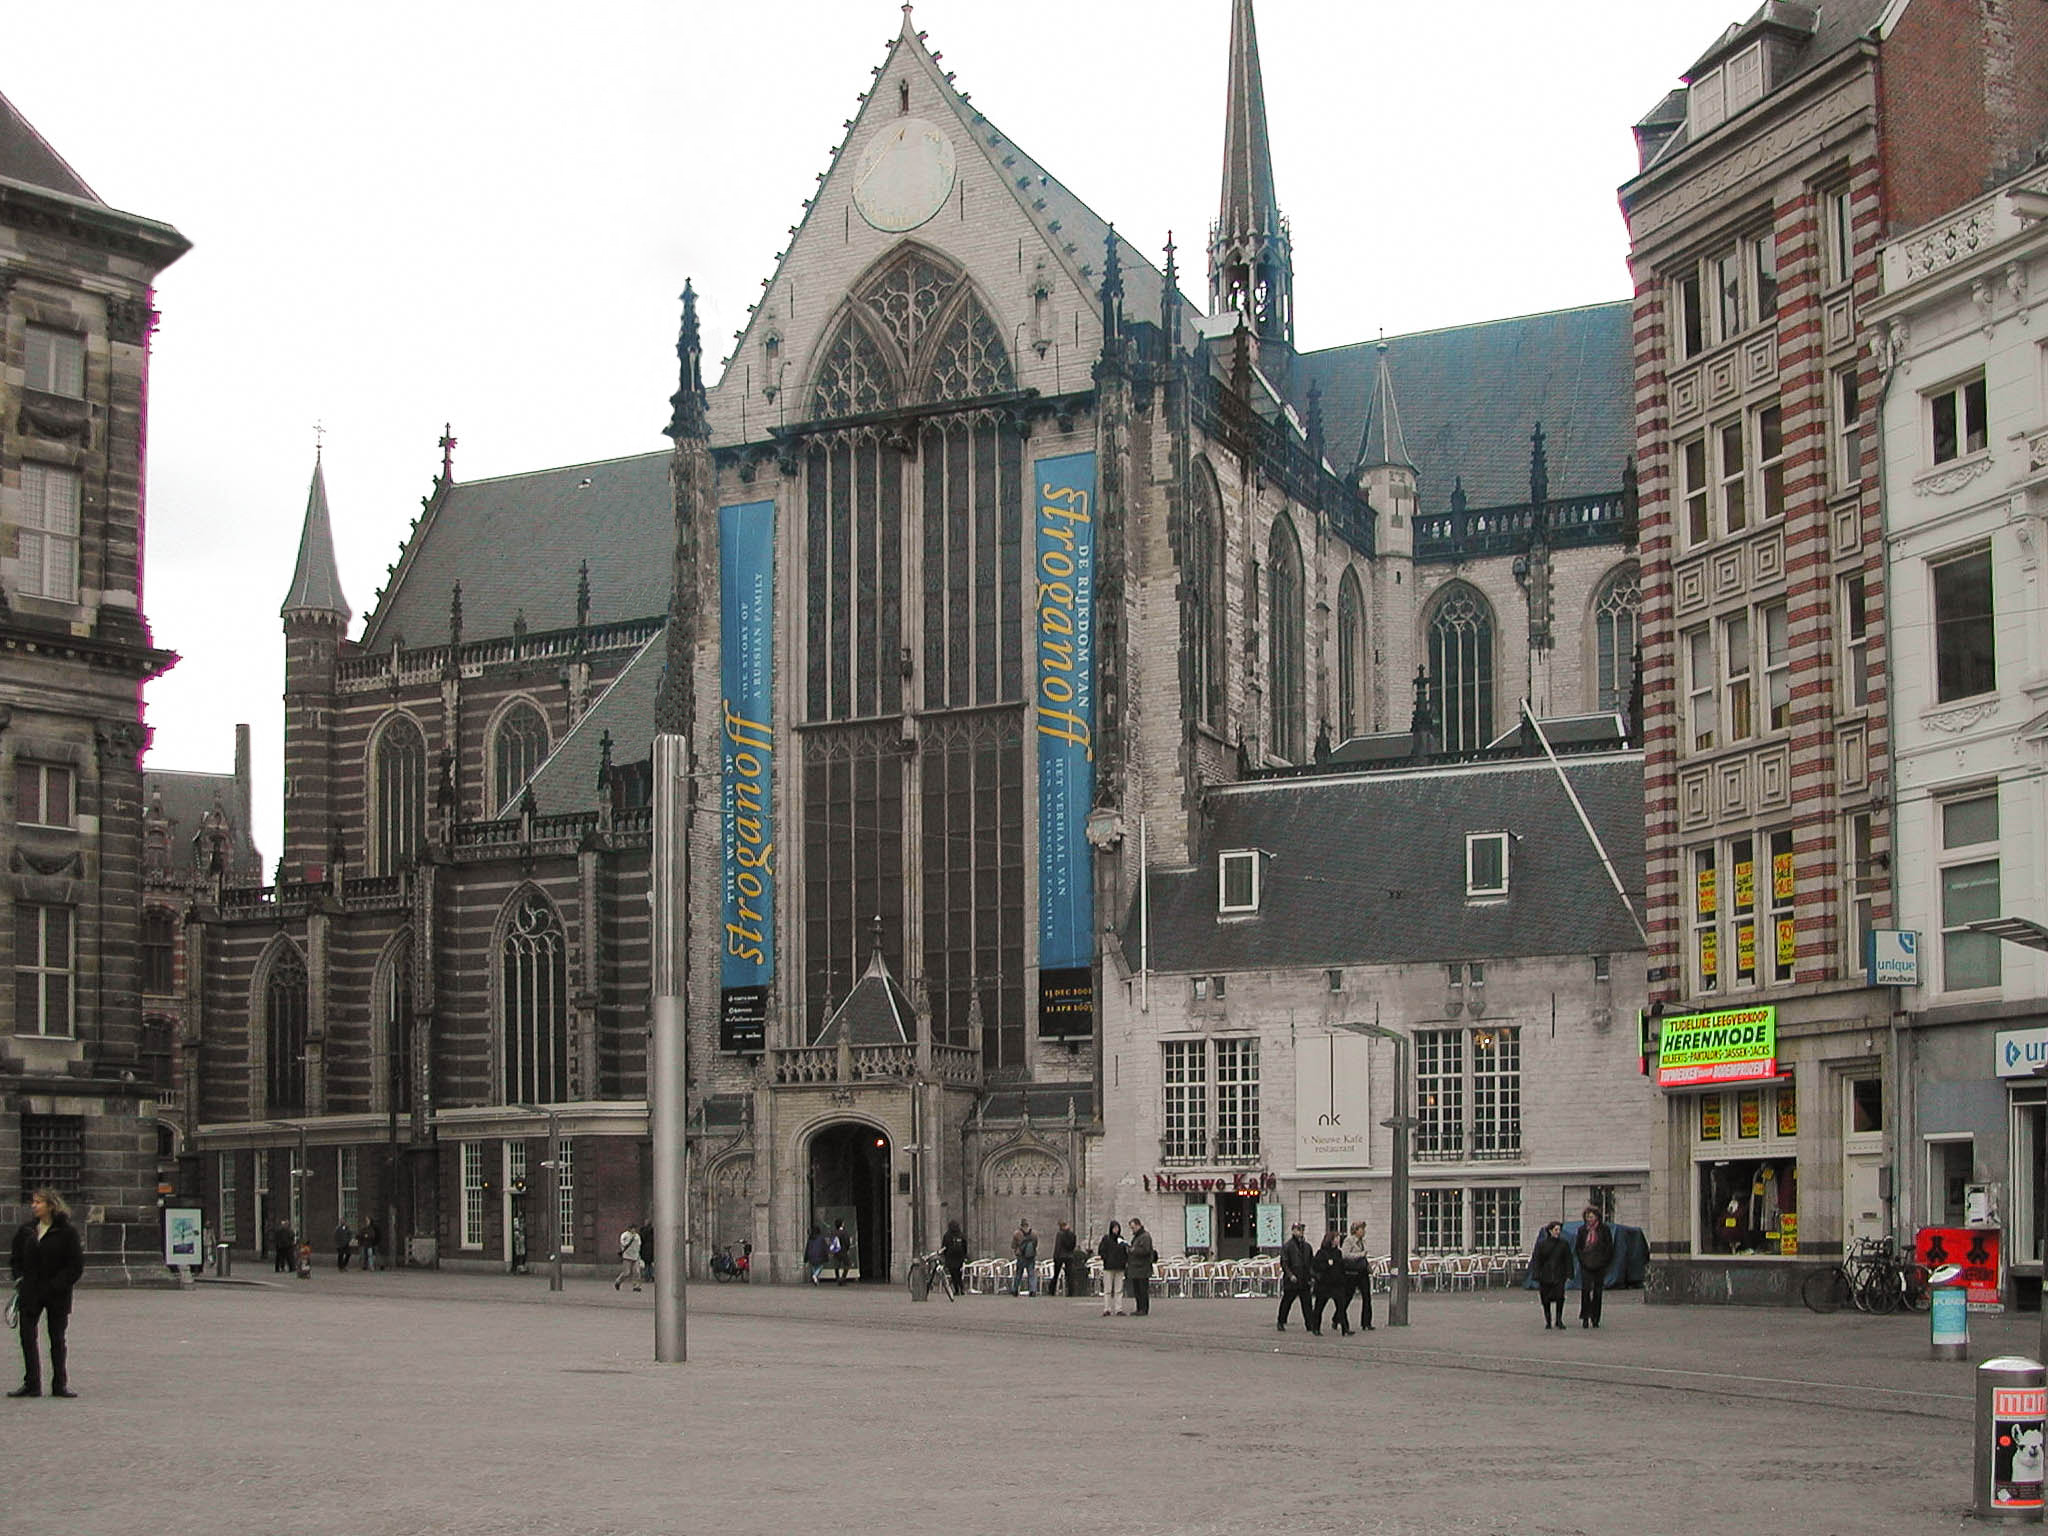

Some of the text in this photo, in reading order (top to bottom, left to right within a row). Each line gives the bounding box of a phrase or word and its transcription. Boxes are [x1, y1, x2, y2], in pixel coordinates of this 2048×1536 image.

[741, 601, 748, 620] OF
[1035, 482, 1094, 761] Stroganoff
[1075, 545, 1090, 709] DE RIJKDOM VAN
[753, 572, 763, 699] A RUSSIAN FAMILY
[723, 699, 773, 965] Stroganoff
[726, 784, 735, 861] WEALTH
[1055, 757, 1066, 897] HET VERHAAL VAN
[1045, 759, 1054, 941] EEN RUSSISCHE FAMILIE
[727, 866, 735, 903] THE
[1877, 959, 1915, 973] unique
[1055, 988, 1071, 996] DEC
[1712, 1011, 1768, 1027] LEEGVERKOOP
[1664, 1025, 1767, 1052] HERENMODE
[1311, 1135, 1341, 1144] Nieuwe
[1155, 1173, 1226, 1192] Nieuwe
